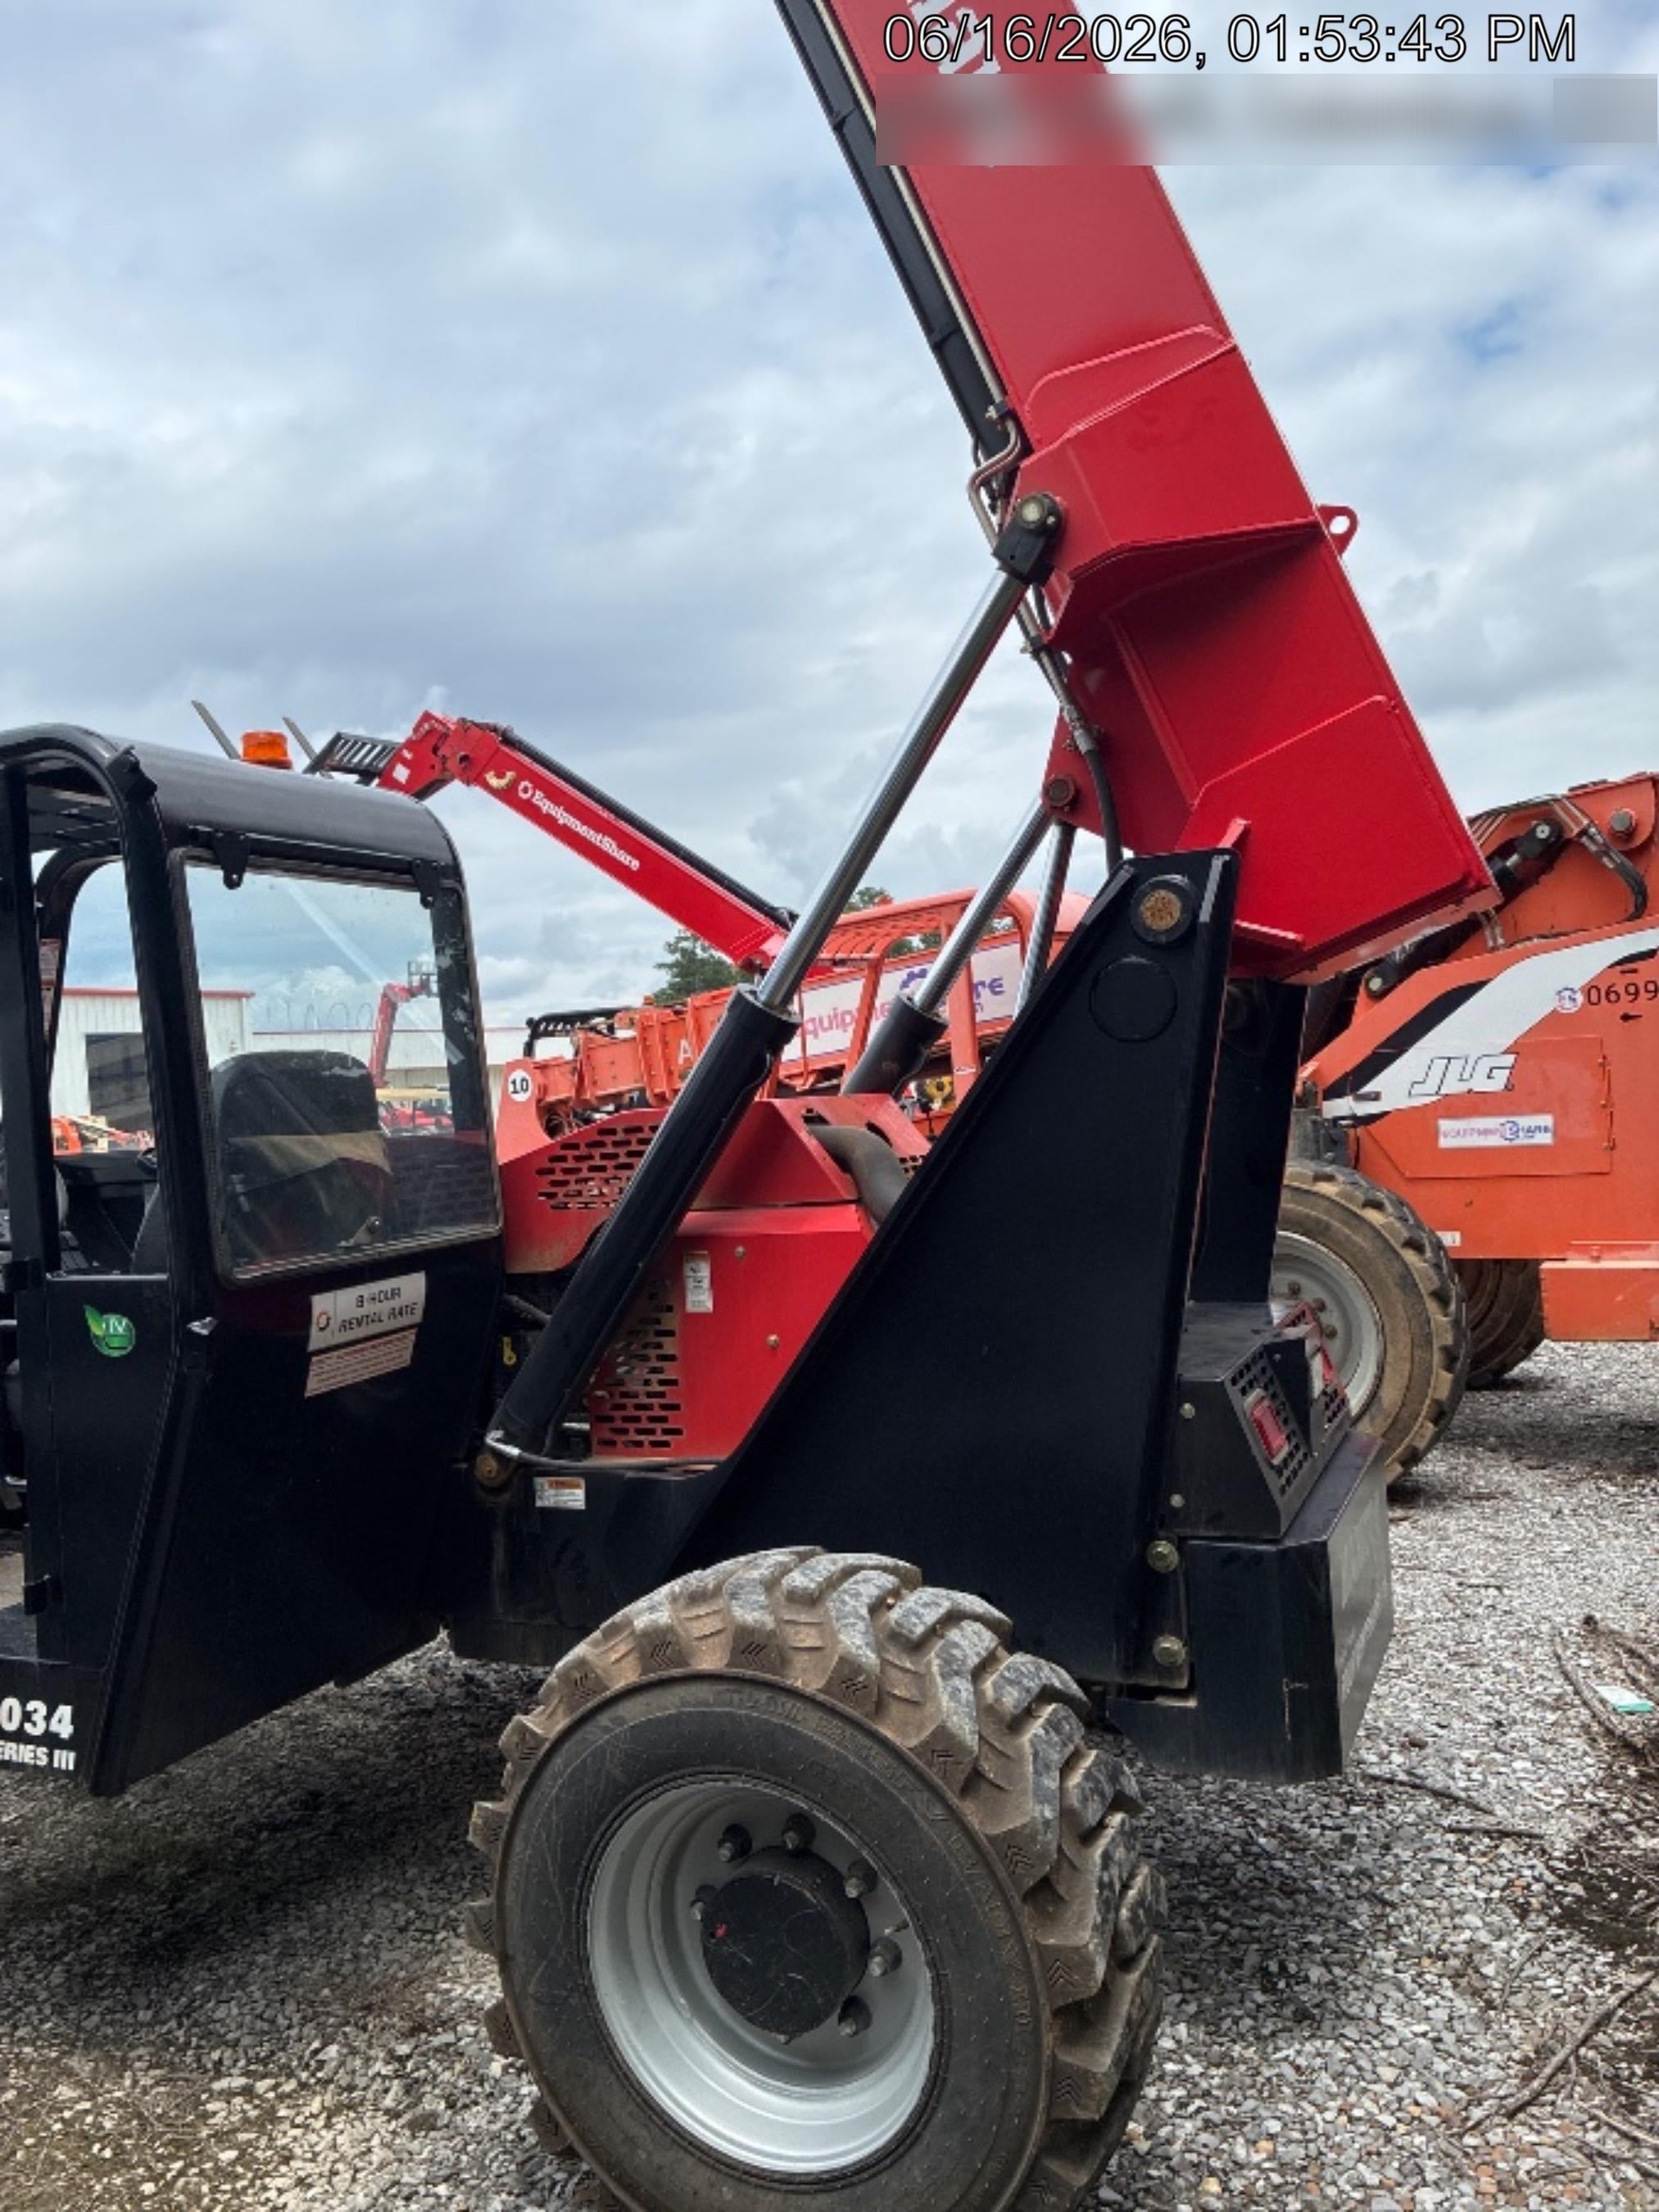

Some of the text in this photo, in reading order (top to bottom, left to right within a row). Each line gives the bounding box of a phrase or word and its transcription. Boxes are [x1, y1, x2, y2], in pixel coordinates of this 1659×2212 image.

[1408, 1052, 1519, 1097] JLG
[510, 1077, 529, 1095] 10
[388, 1302, 419, 1321] RATE
[0, 1696, 75, 1741] 034
[52, 1749, 77, 1770] III
